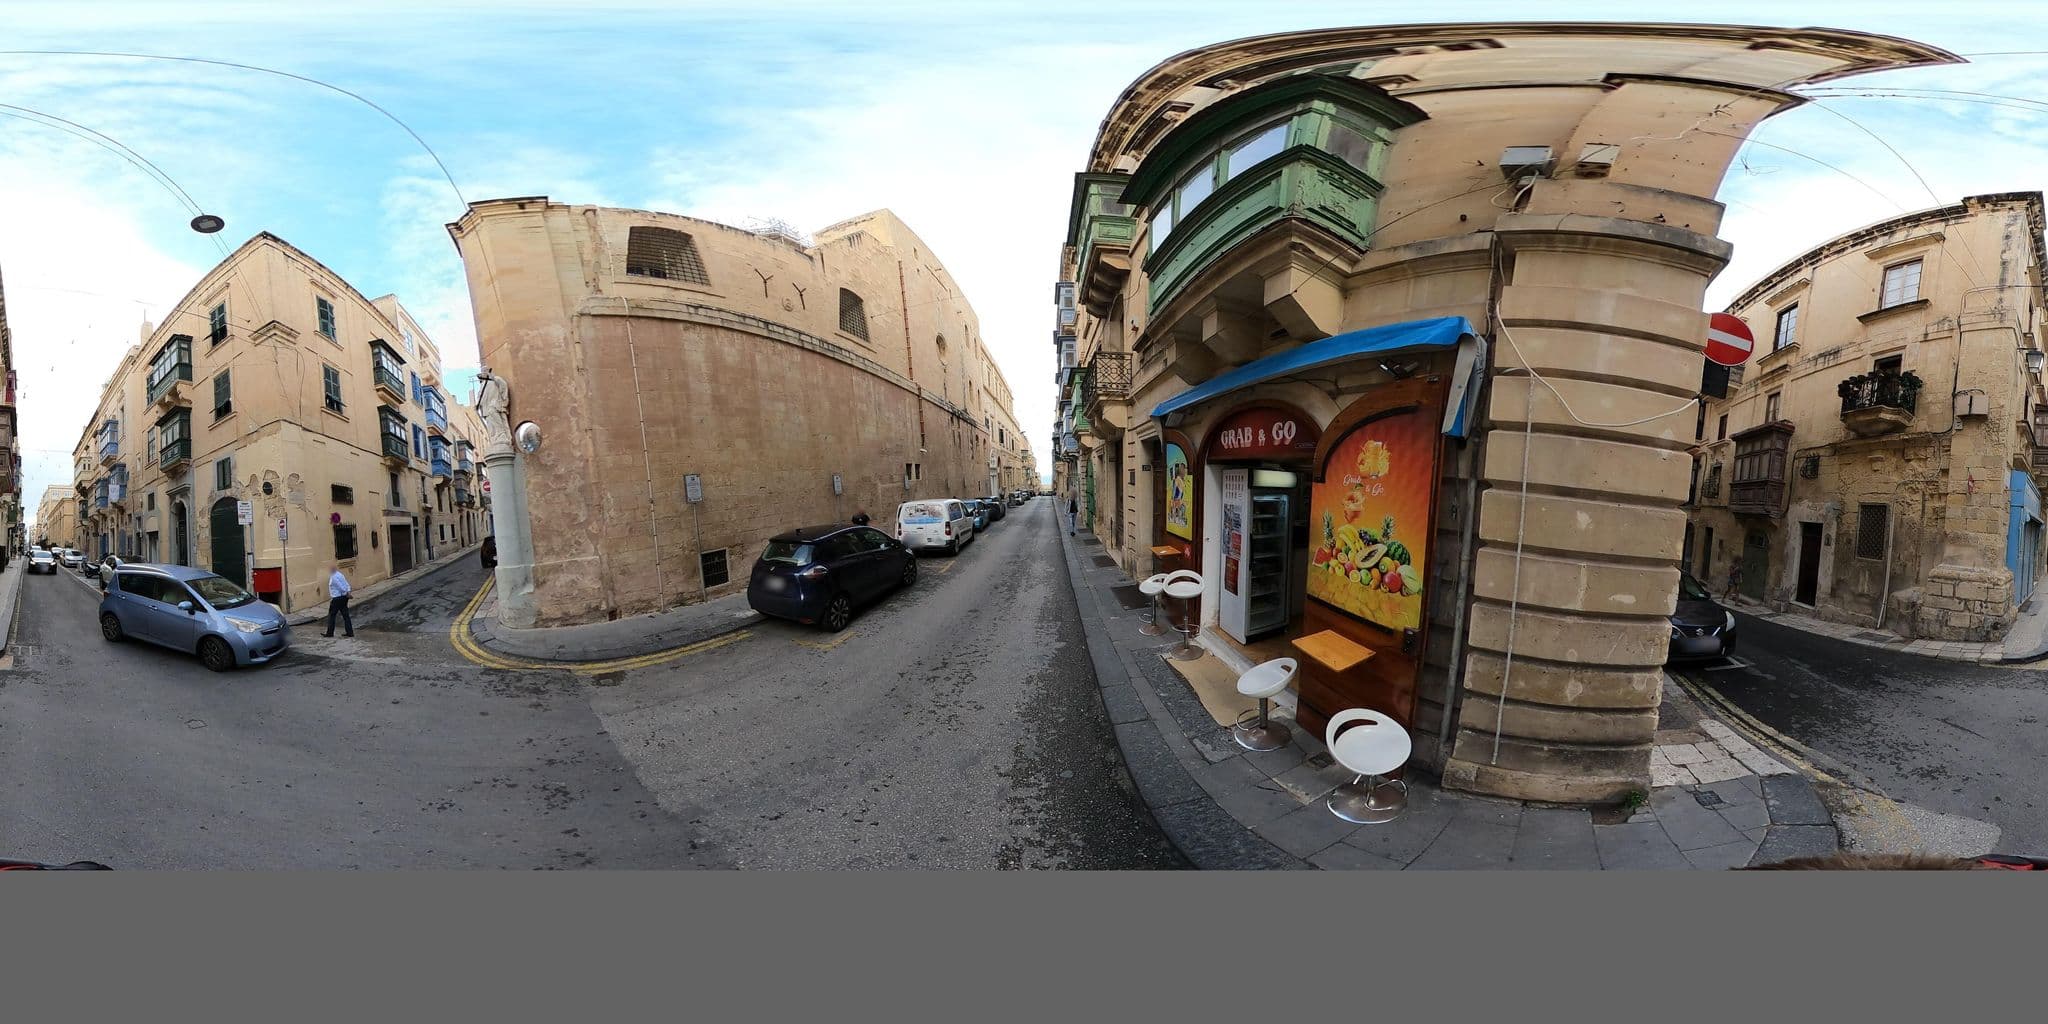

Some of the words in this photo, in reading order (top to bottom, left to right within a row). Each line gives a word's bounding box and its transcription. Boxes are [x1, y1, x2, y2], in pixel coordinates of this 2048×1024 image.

[1221, 427, 1253, 448] GRAB
[1258, 428, 1266, 443] &
[1272, 420, 1297, 442] GO
[1372, 483, 1384, 496] Go
